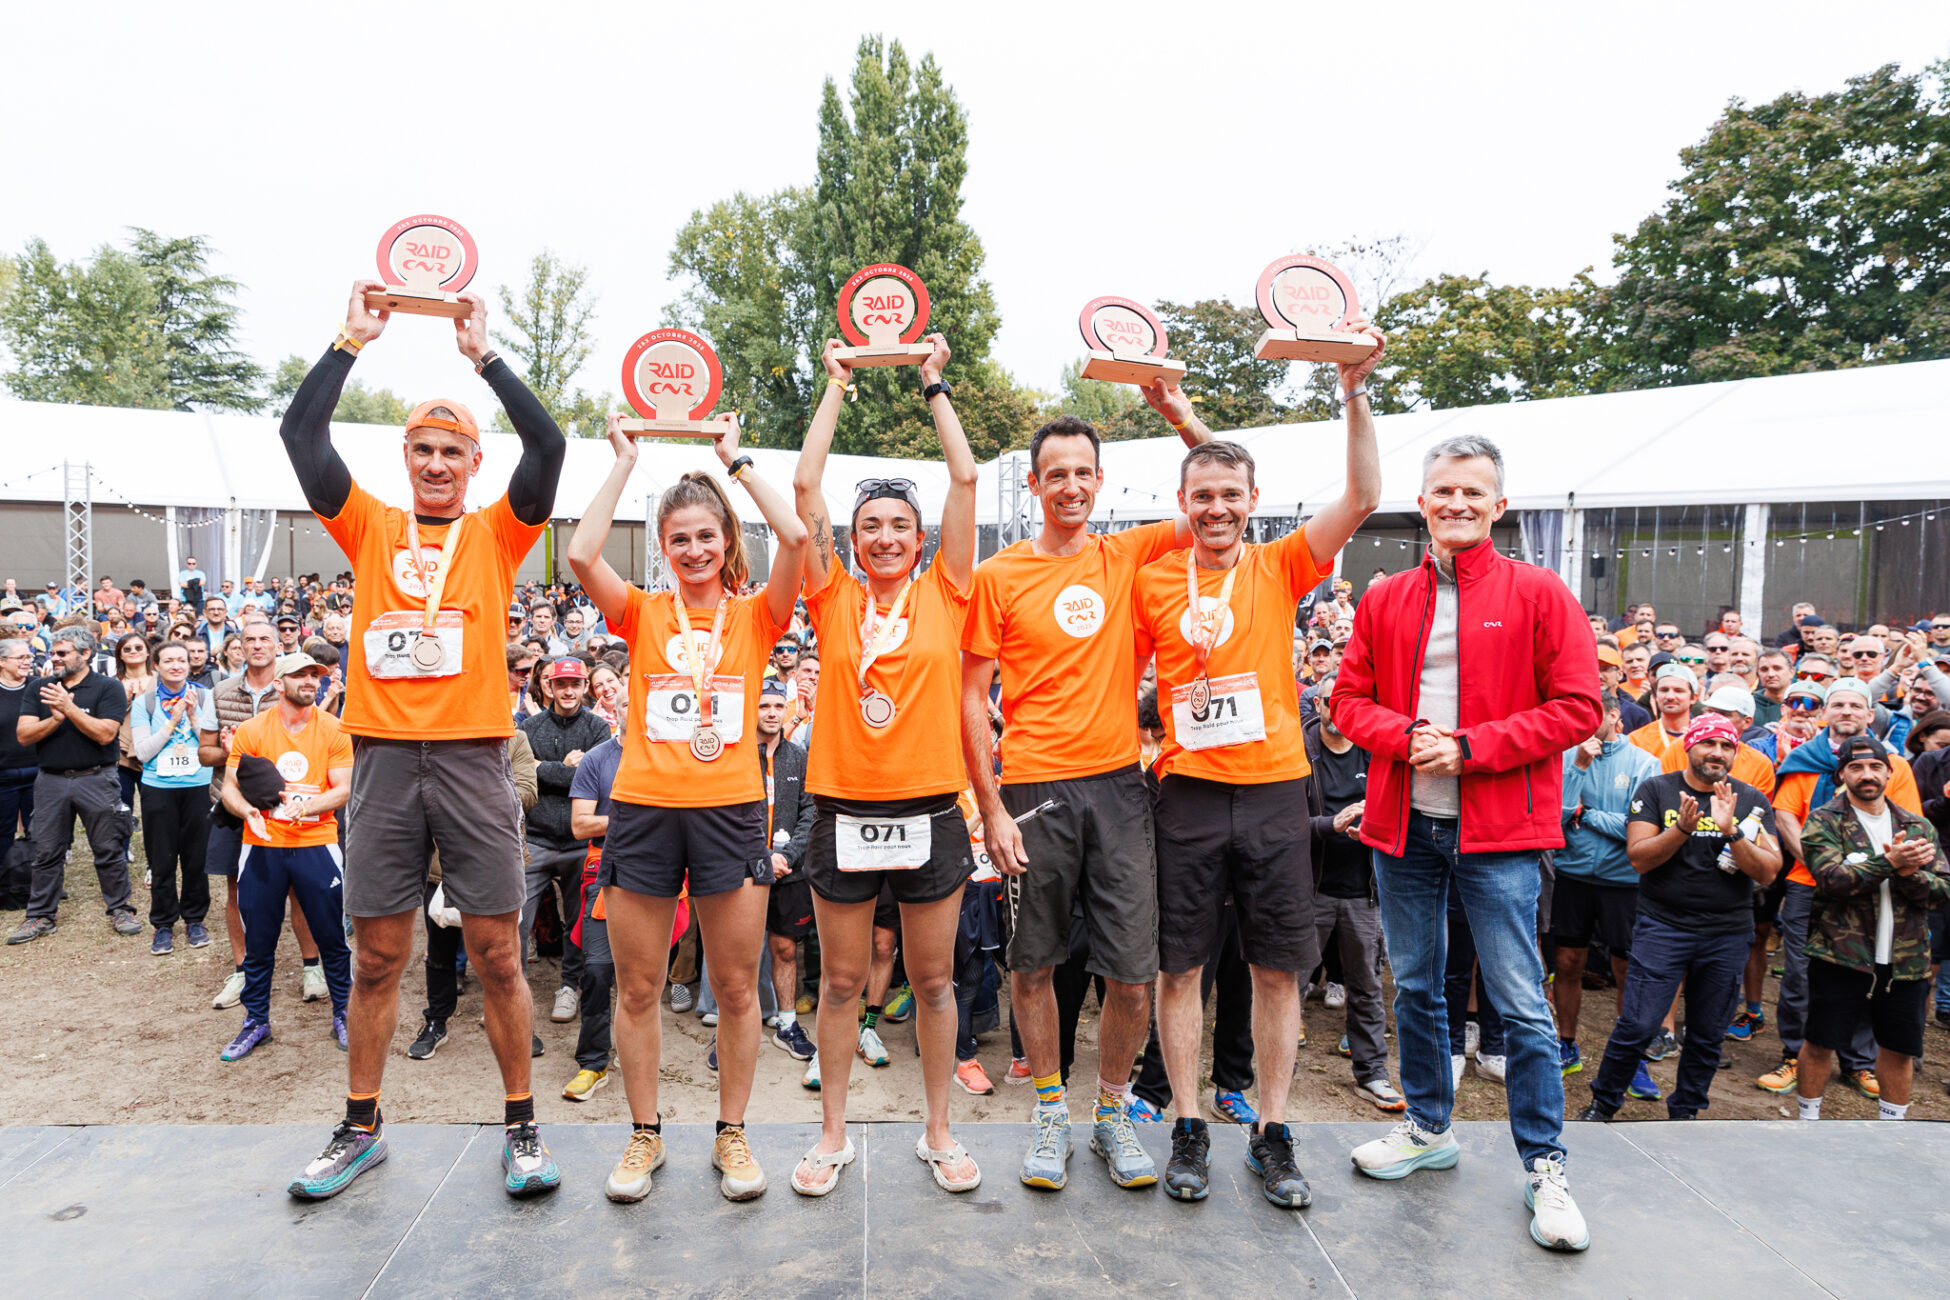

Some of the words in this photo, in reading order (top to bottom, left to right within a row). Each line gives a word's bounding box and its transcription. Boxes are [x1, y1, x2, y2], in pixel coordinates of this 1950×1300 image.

[412, 217, 448, 226] OCTOBRE
[405, 242, 451, 259] RAID
[402, 259, 446, 275] CNR
[864, 267, 897, 277] OCTOBRE
[898, 270, 914, 282] 2025
[1283, 285, 1331, 301] RAID
[862, 295, 905, 311] RAID
[1287, 303, 1333, 316] CNR
[863, 312, 904, 326] CNR
[1103, 319, 1143, 335] RAID
[651, 332, 687, 340] OCTOBRE
[688, 337, 705, 351] 2025
[1106, 333, 1146, 347] CNR
[648, 362, 695, 379] RAID
[648, 382, 695, 396] CNR
[1062, 598, 1094, 613] RAID
[1067, 610, 1097, 625] CNR
[170, 756, 190, 766] 118
[860, 823, 906, 843] 071
